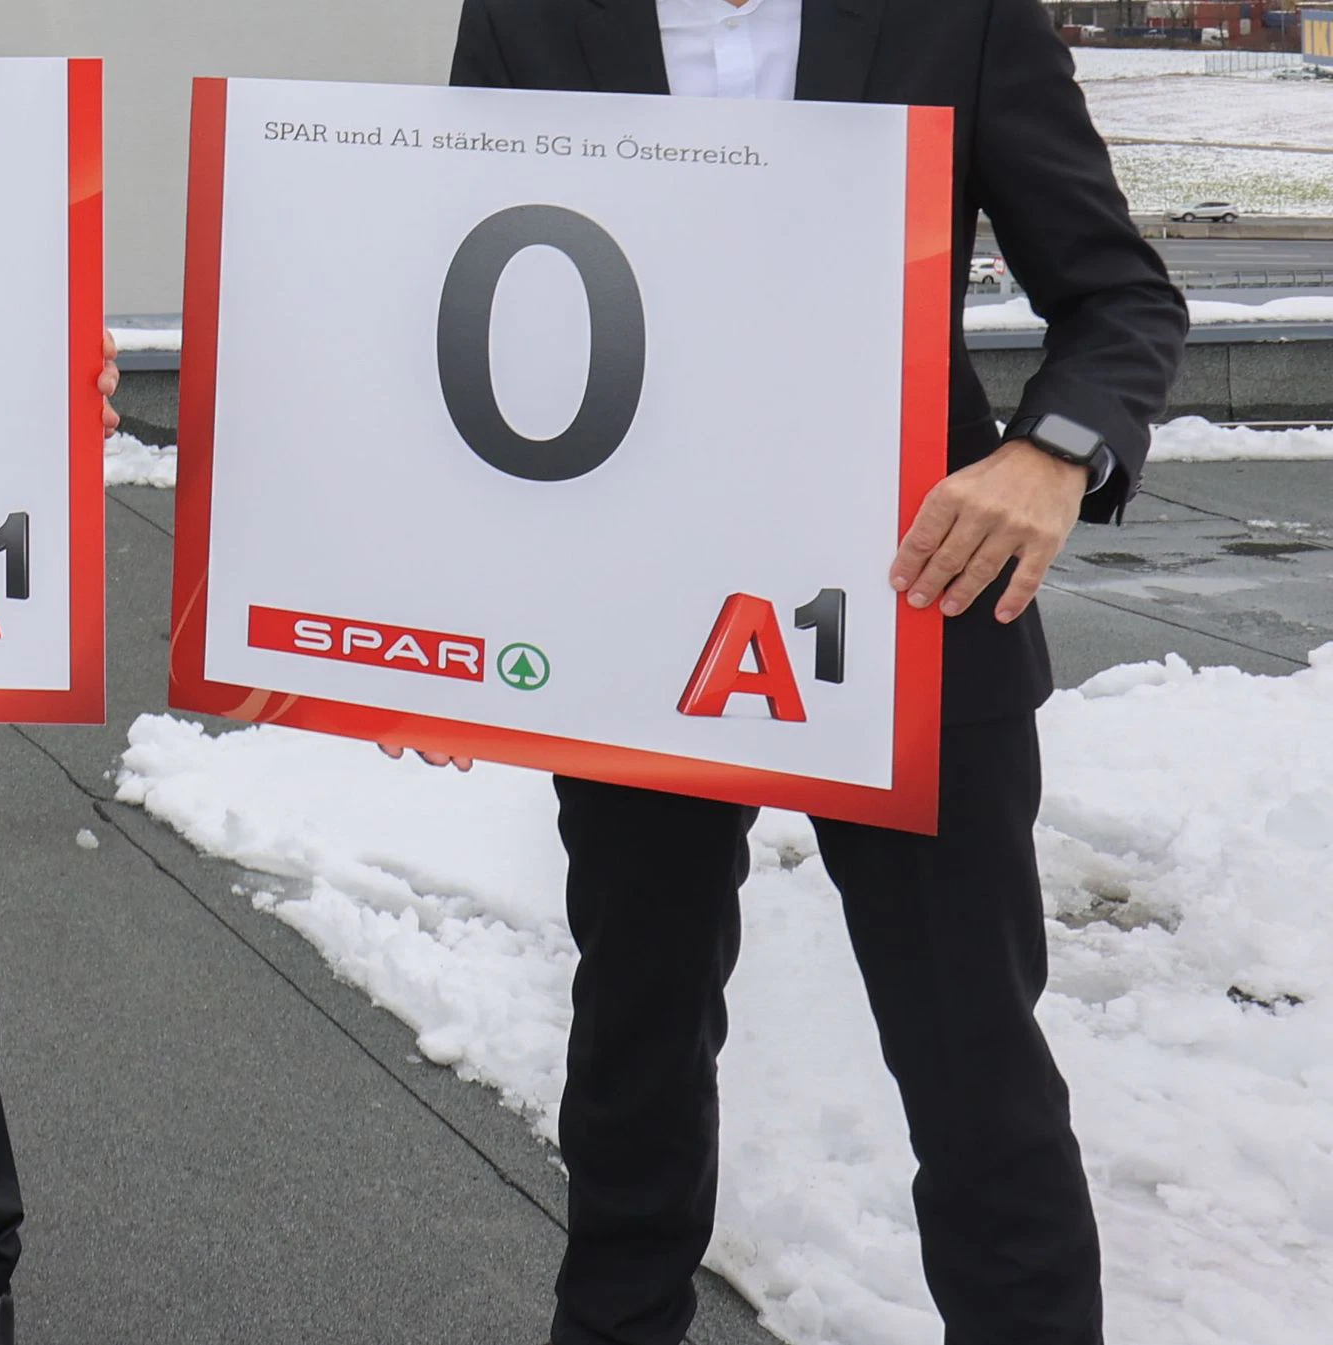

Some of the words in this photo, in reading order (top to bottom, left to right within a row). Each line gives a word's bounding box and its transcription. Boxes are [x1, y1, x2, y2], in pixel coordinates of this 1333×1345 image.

[264, 121, 328, 143] SPAR
[336, 126, 383, 146] und
[389, 128, 423, 148] A1
[432, 132, 526, 154] stärken
[535, 135, 572, 156] 5G
[582, 138, 607, 158] in
[616, 134, 768, 167] Österreich.
[436, 204, 646, 483] 0
[293, 618, 479, 674] SPAR
[676, 588, 847, 724] A1
